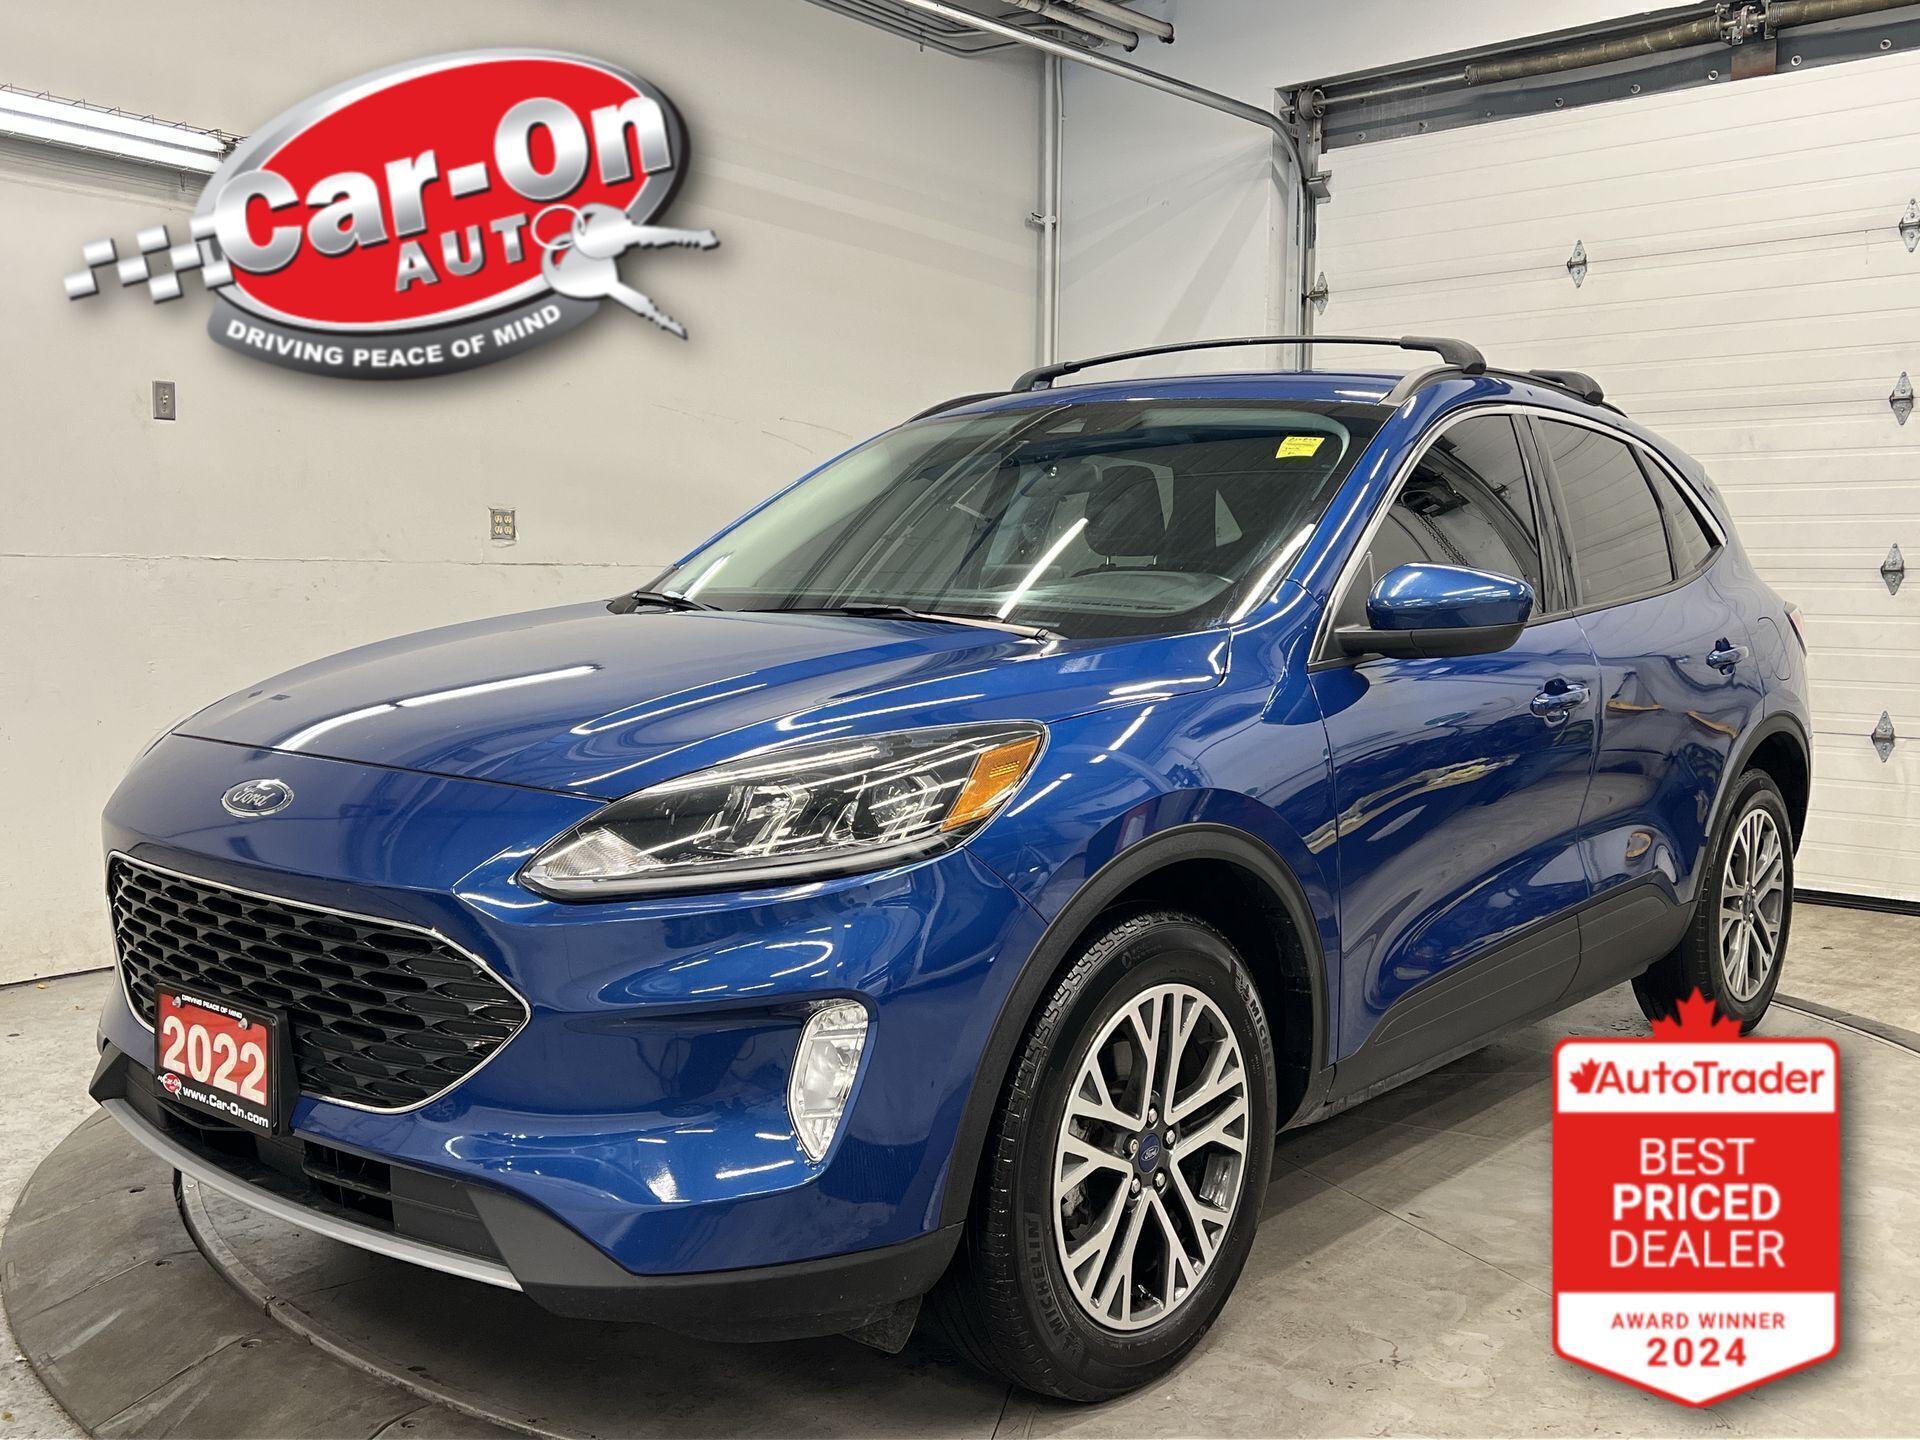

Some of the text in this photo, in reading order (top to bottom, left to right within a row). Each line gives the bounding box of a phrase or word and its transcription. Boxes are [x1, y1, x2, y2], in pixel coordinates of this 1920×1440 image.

[232, 784, 276, 807] Ford
[203, 1000, 220, 1012] PEACE
[220, 1006, 228, 1014] OF
[162, 1015, 267, 1107] 2022
[182, 1086, 269, 1128] www.Car-On.com
[1028, 1220, 1066, 1337] MICHELIN
